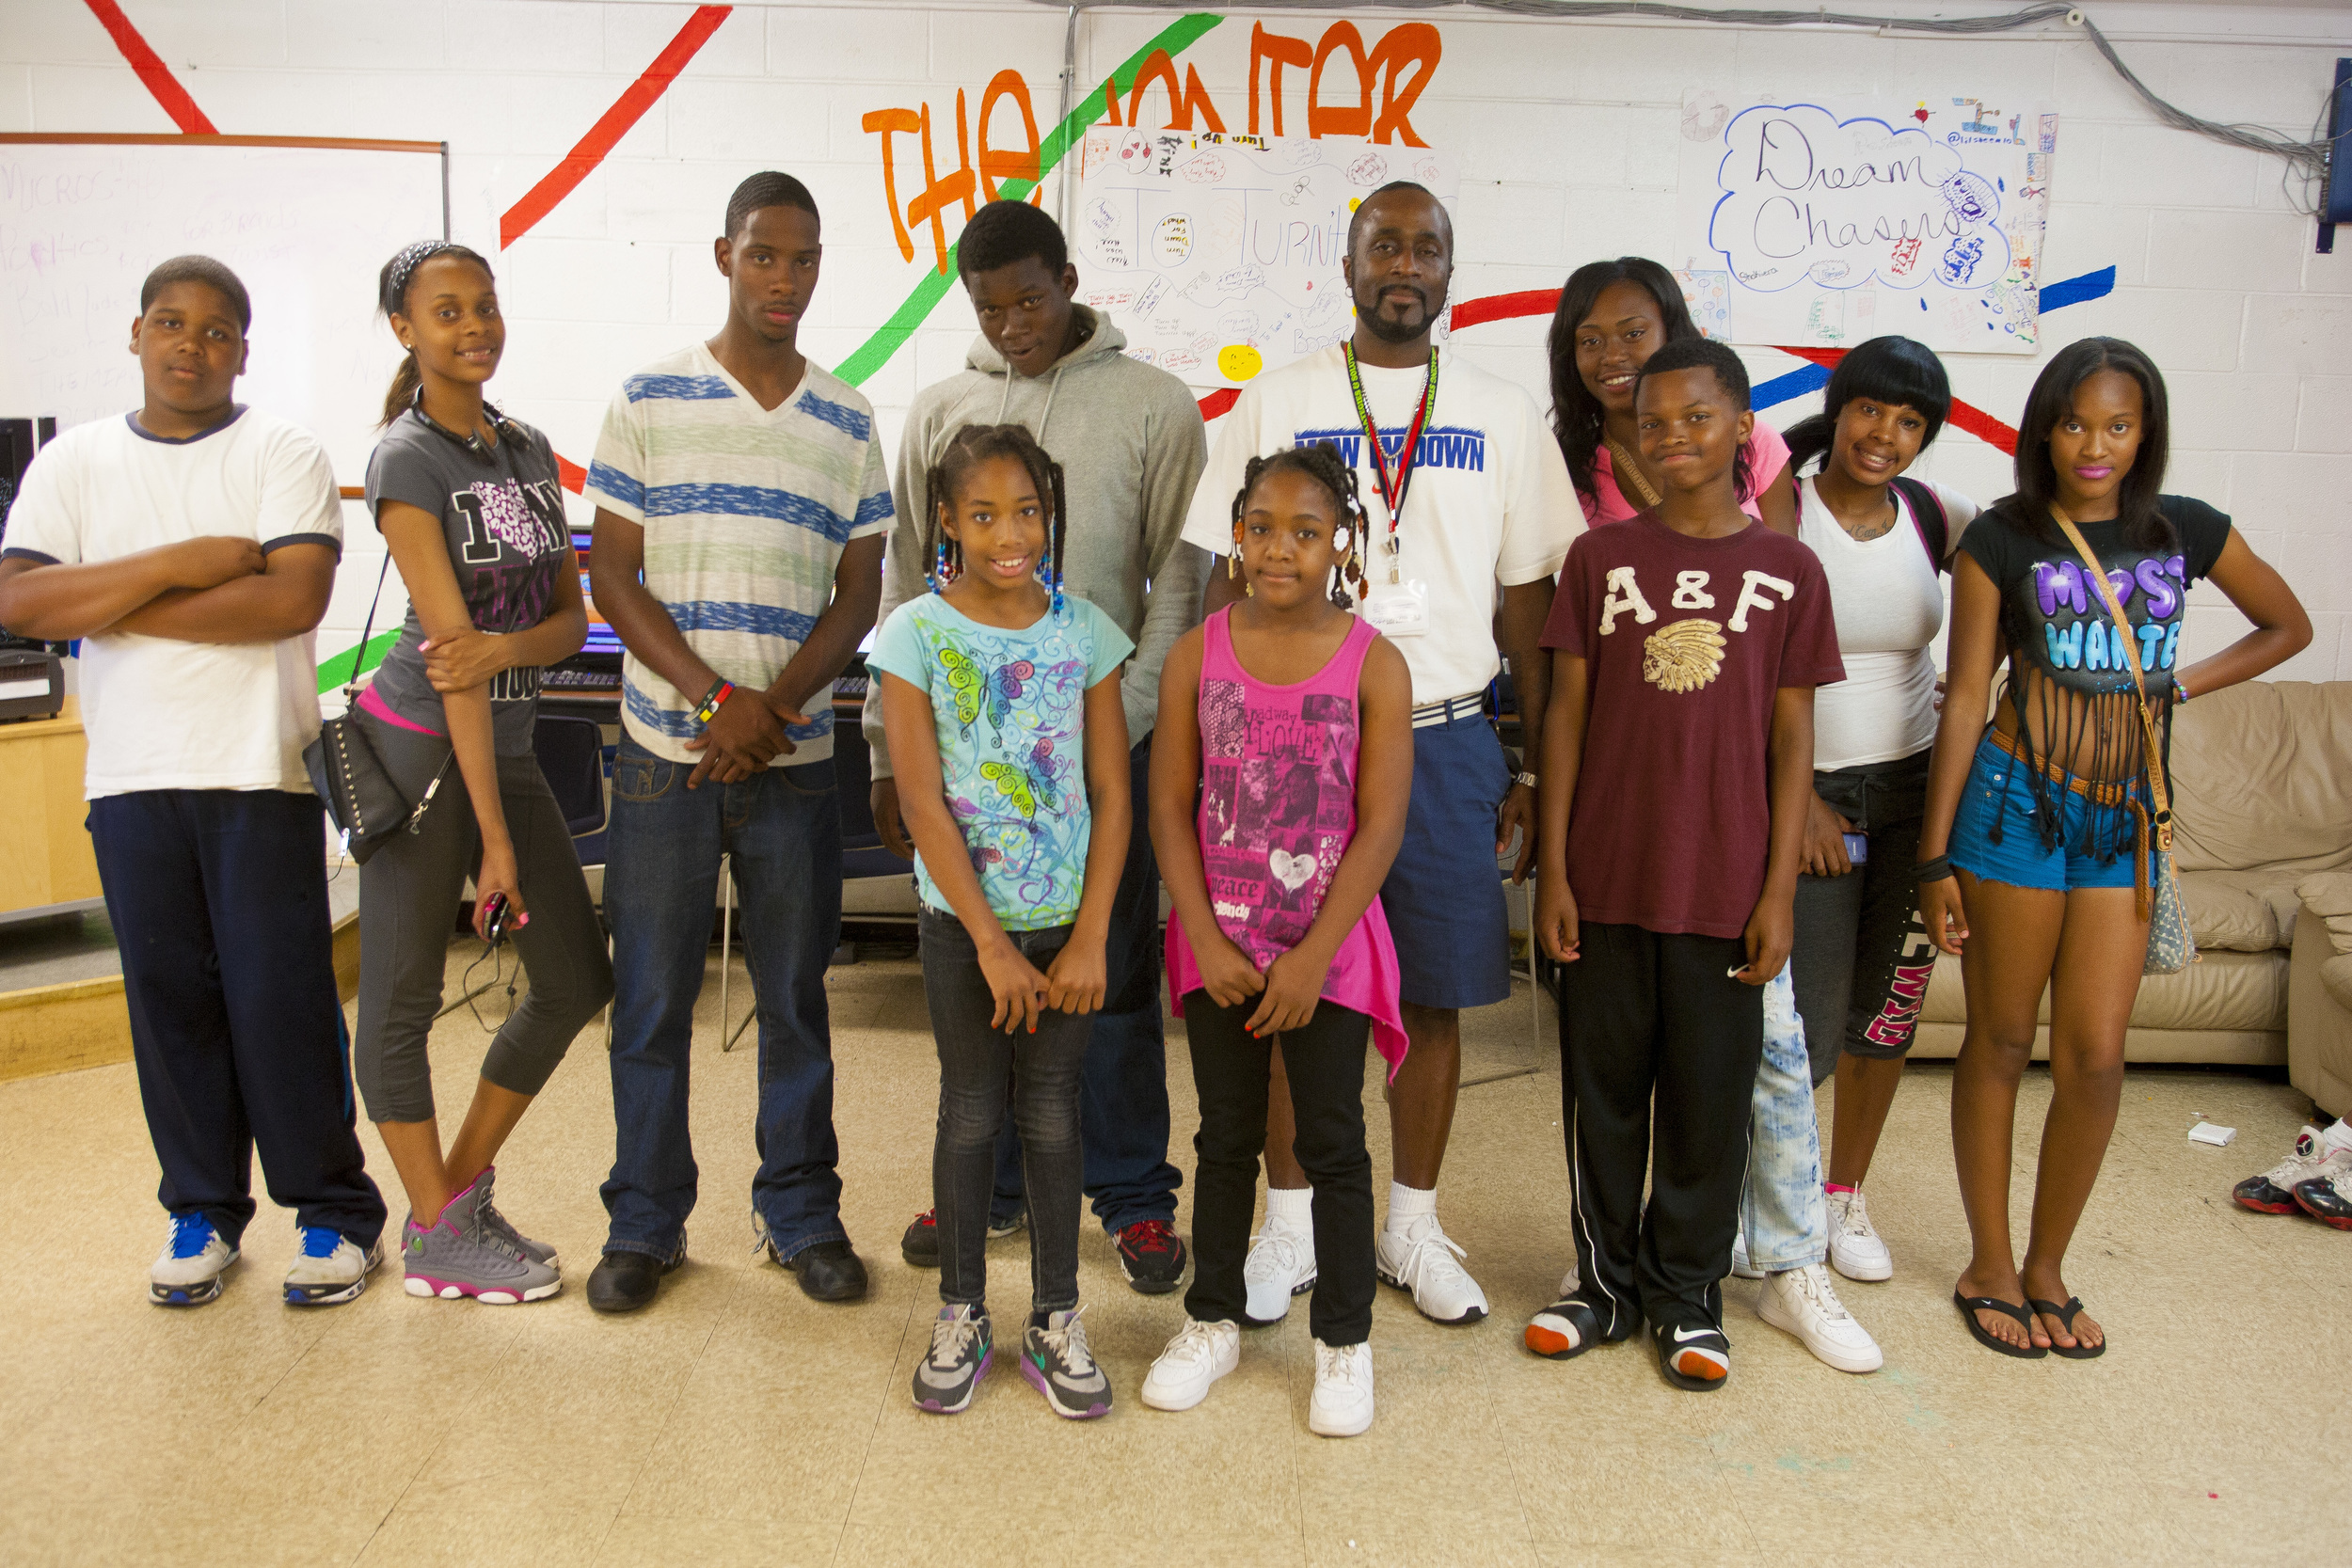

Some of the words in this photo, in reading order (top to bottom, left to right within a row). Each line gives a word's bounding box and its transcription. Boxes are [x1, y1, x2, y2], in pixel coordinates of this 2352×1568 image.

[862, 69, 1041, 276] THE
[1756, 119, 1947, 191] Dream
[1754, 196, 1972, 259] Chasers
[1413, 436, 1484, 472] DOWN
[1599, 566, 1657, 636] A
[1672, 570, 1715, 609] &
[1728, 570, 1794, 632] F
[1257, 720, 1318, 763] LOVE
